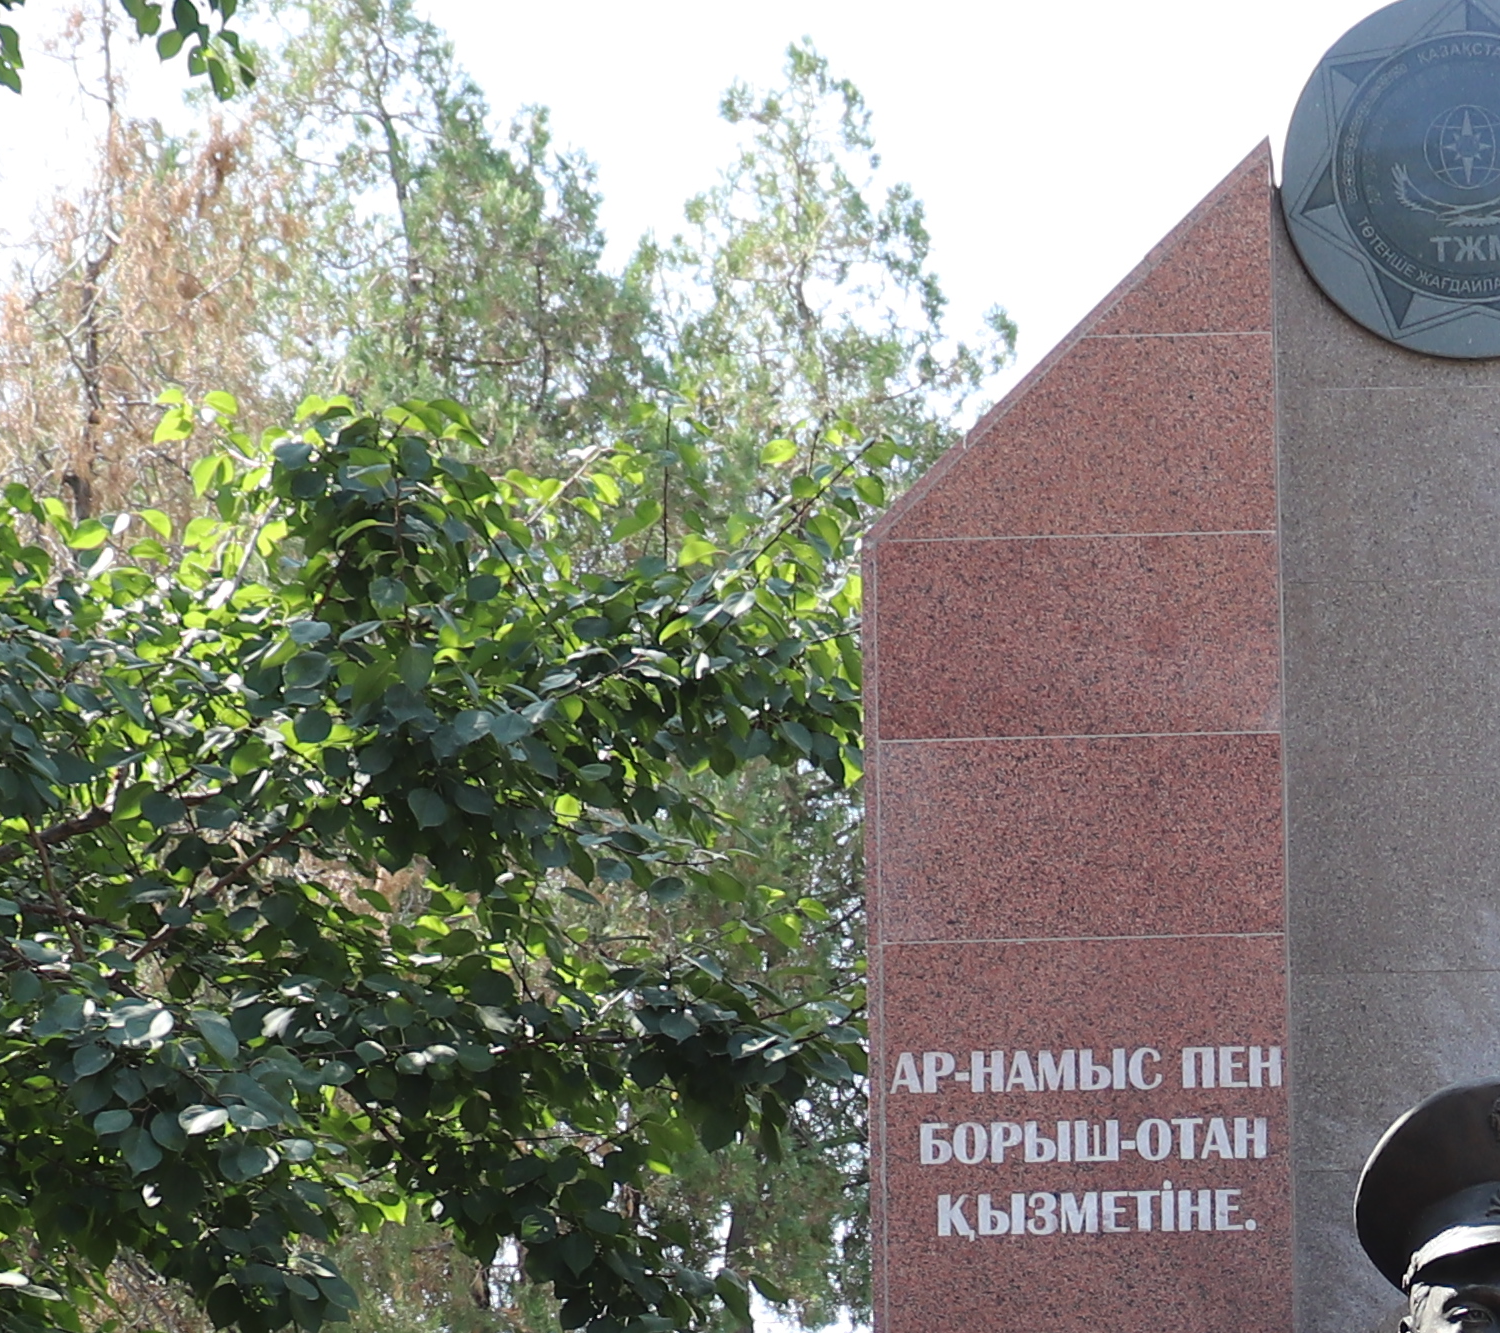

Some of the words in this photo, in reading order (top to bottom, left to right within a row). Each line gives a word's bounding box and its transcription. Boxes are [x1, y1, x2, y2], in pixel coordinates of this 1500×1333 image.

[1357, 216, 1421, 279] ТӨТЕНШЕ
[890, 1046, 1163, 1094] АР-НАМЫС
[1181, 1045, 1283, 1089] ПЕН
[919, 1117, 1268, 1165] БОРЫШ-ОТАН
[937, 1179, 1257, 1241] ҚЫЗМЕТІНЕ.
